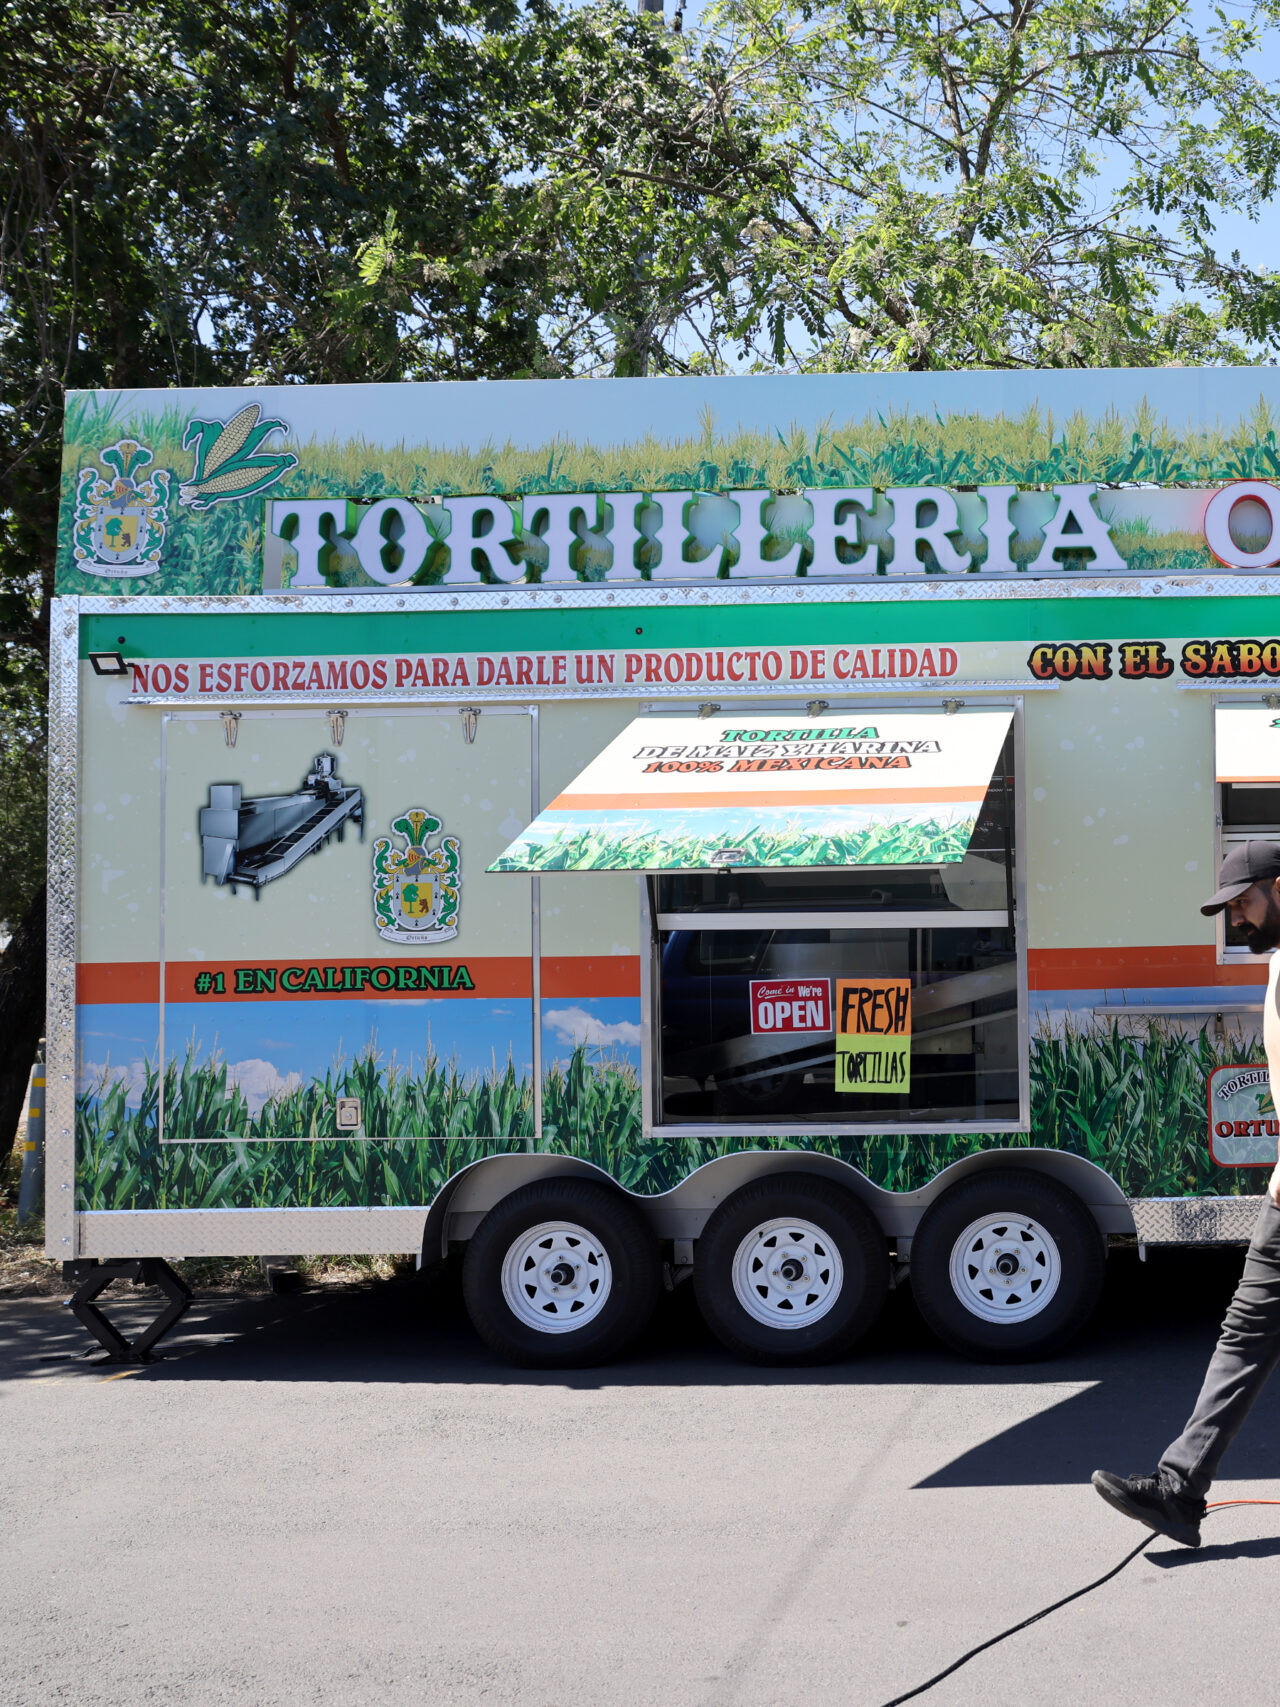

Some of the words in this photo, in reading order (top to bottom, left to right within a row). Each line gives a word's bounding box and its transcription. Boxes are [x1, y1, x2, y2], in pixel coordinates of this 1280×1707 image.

[272, 483, 1128, 587] TORTILLERIA
[132, 663, 190, 693] NOS
[198, 660, 388, 693] ESFORZAMOS
[395, 657, 466, 688] PARA
[477, 654, 567, 687] DARLE
[575, 654, 615, 684] UN
[624, 651, 783, 683] PRODUCTO
[789, 650, 826, 680] DE
[833, 647, 958, 680] CALIDAD
[1029, 645, 1109, 680] CON
[1121, 643, 1172, 676] EL
[720, 727, 879, 743] TORTILLA
[633, 746, 688, 759] DE
[687, 744, 778, 759] MAIZ
[779, 743, 809, 757] Y
[805, 741, 942, 756] HARINA
[642, 760, 724, 774] 100%
[727, 756, 912, 773] MEXICANA
[197, 972, 226, 992] #1
[236, 969, 277, 991] EN
[280, 966, 474, 992] CALIFORNIA
[757, 985, 783, 999] Come
[785, 984, 795, 994] in
[798, 985, 823, 998] We're
[758, 1000, 824, 1030] OPEN
[841, 986, 909, 1035] FRESH
[837, 1050, 907, 1084] TORTILLAS
[1218, 1071, 1270, 1100] TORTIL
[1215, 1120, 1280, 1138] ORTU
